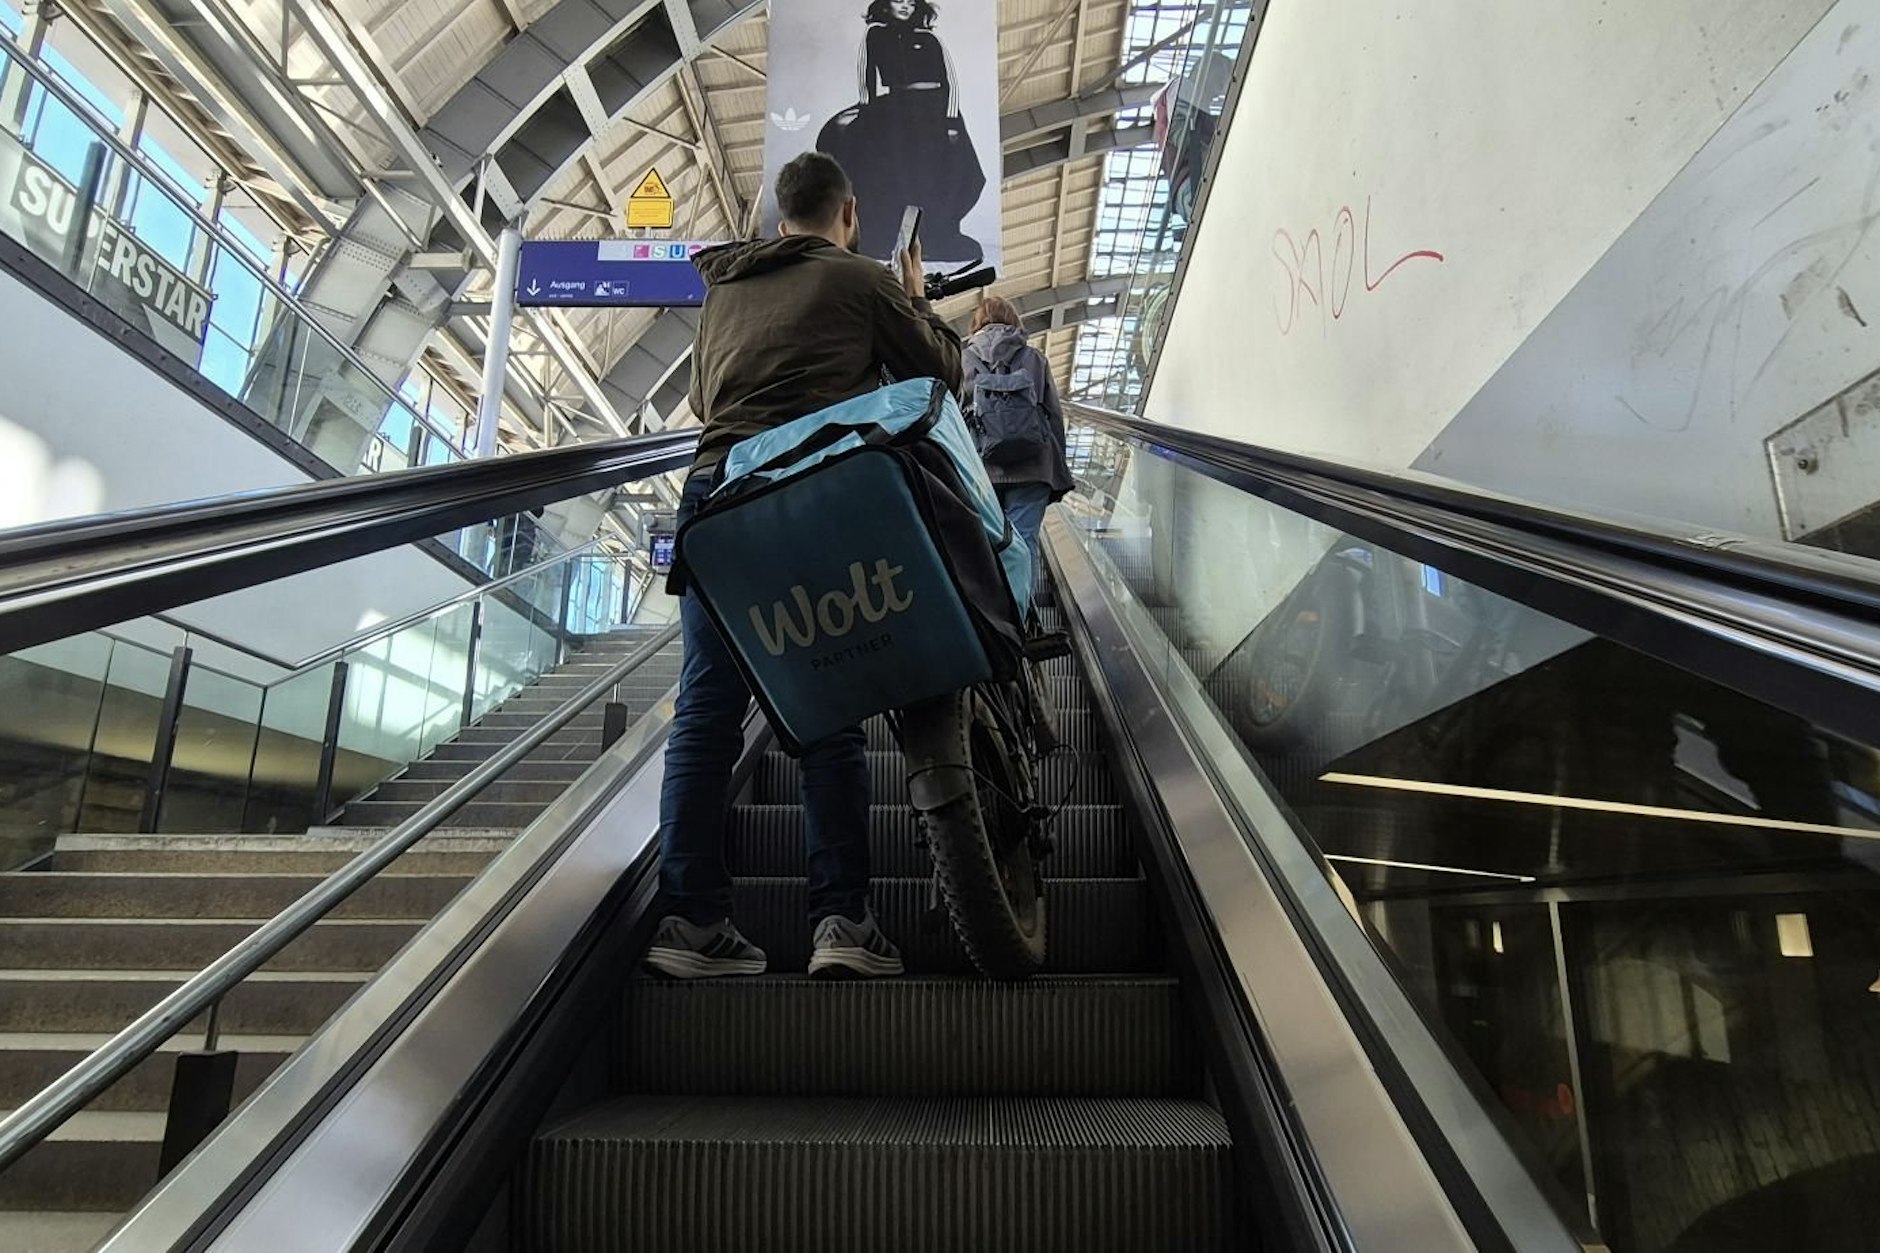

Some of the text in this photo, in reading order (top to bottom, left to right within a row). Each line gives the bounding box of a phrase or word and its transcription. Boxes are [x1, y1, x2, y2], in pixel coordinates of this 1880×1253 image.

[653, 245, 684, 258] S U
[550, 280, 586, 291] Ausgang
[613, 287, 625, 295] WC
[748, 558, 914, 656] Wolt
[810, 633, 894, 671] PARTNER
